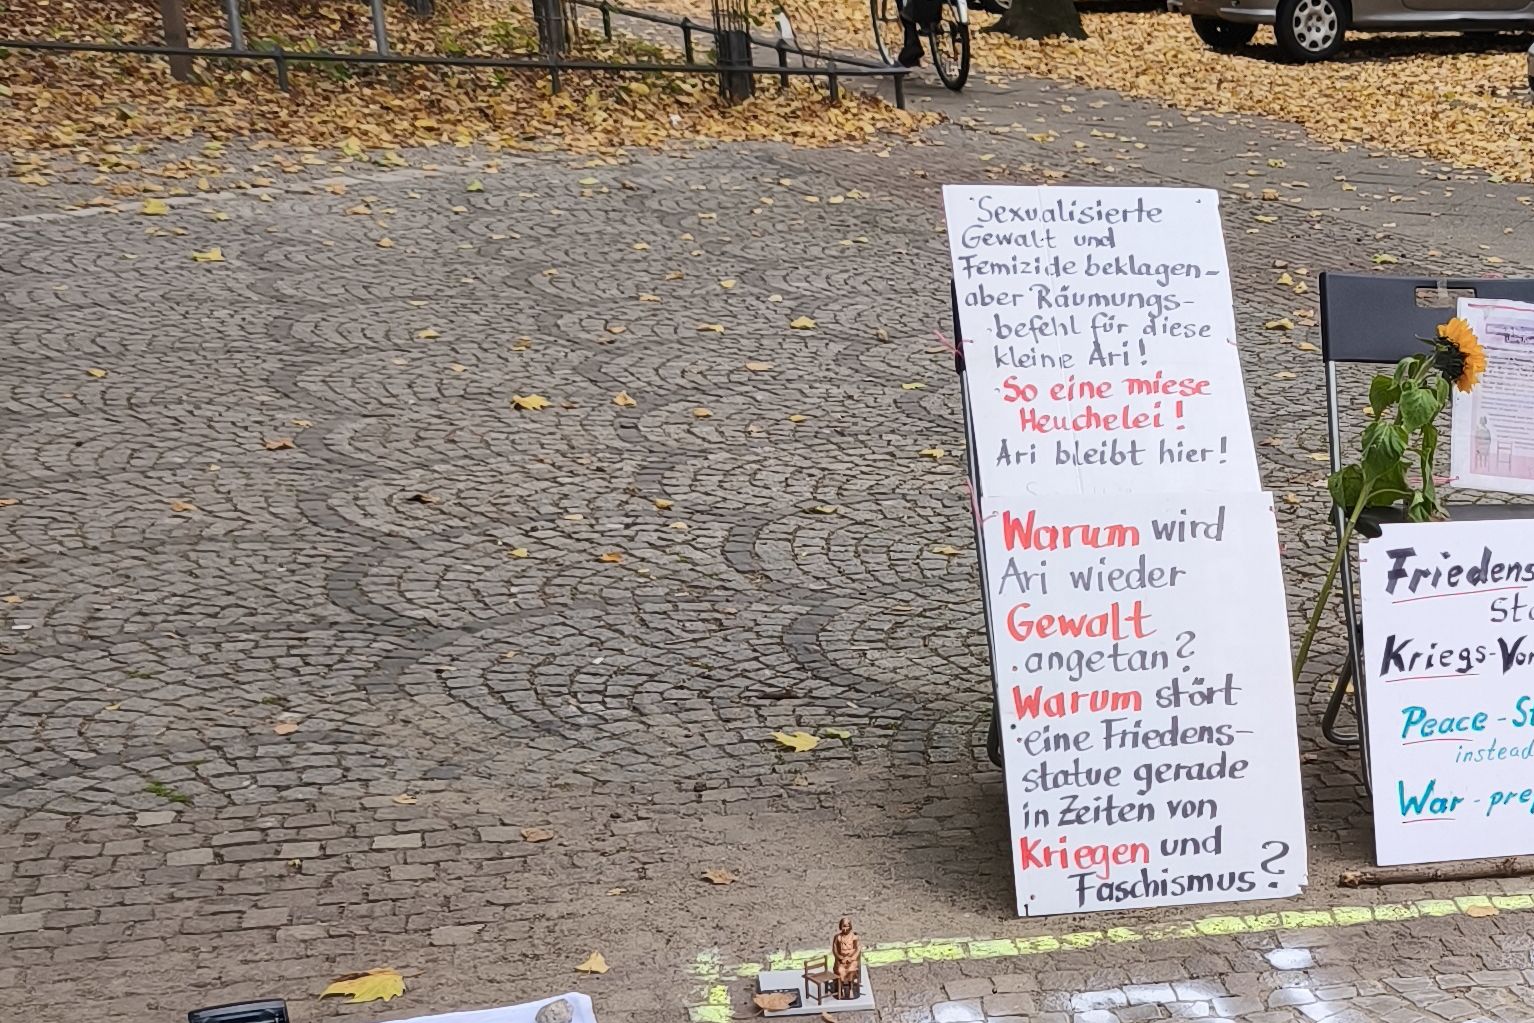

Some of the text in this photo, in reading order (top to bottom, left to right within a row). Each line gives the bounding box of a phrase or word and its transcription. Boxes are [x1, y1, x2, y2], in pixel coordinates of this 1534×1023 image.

[976, 196, 1163, 224] Sexualisierte
[961, 225, 1116, 249] Gewalt und
[958, 253, 1078, 279] Femizide
[965, 284, 1195, 318] aber Räumungs-
[994, 312, 1212, 343] befehl für diese
[994, 339, 1147, 369] kleine Ari!
[1002, 370, 1212, 403] So eine miese
[996, 436, 1228, 466] Ari bleibt hier!
[1002, 505, 1225, 552] Warum wird
[998, 553, 1186, 595] Ari wieder
[1006, 600, 1158, 642] Gewalt
[1024, 630, 1196, 683] angetan?
[1012, 673, 1243, 721] Warum stört
[1023, 716, 1254, 757] eine Friedens-
[1455, 738, 1534, 764] instead
[1021, 751, 1250, 796] statue gerade
[1022, 794, 1218, 830] in Zeiten von
[1020, 825, 1223, 880] Kriegen und
